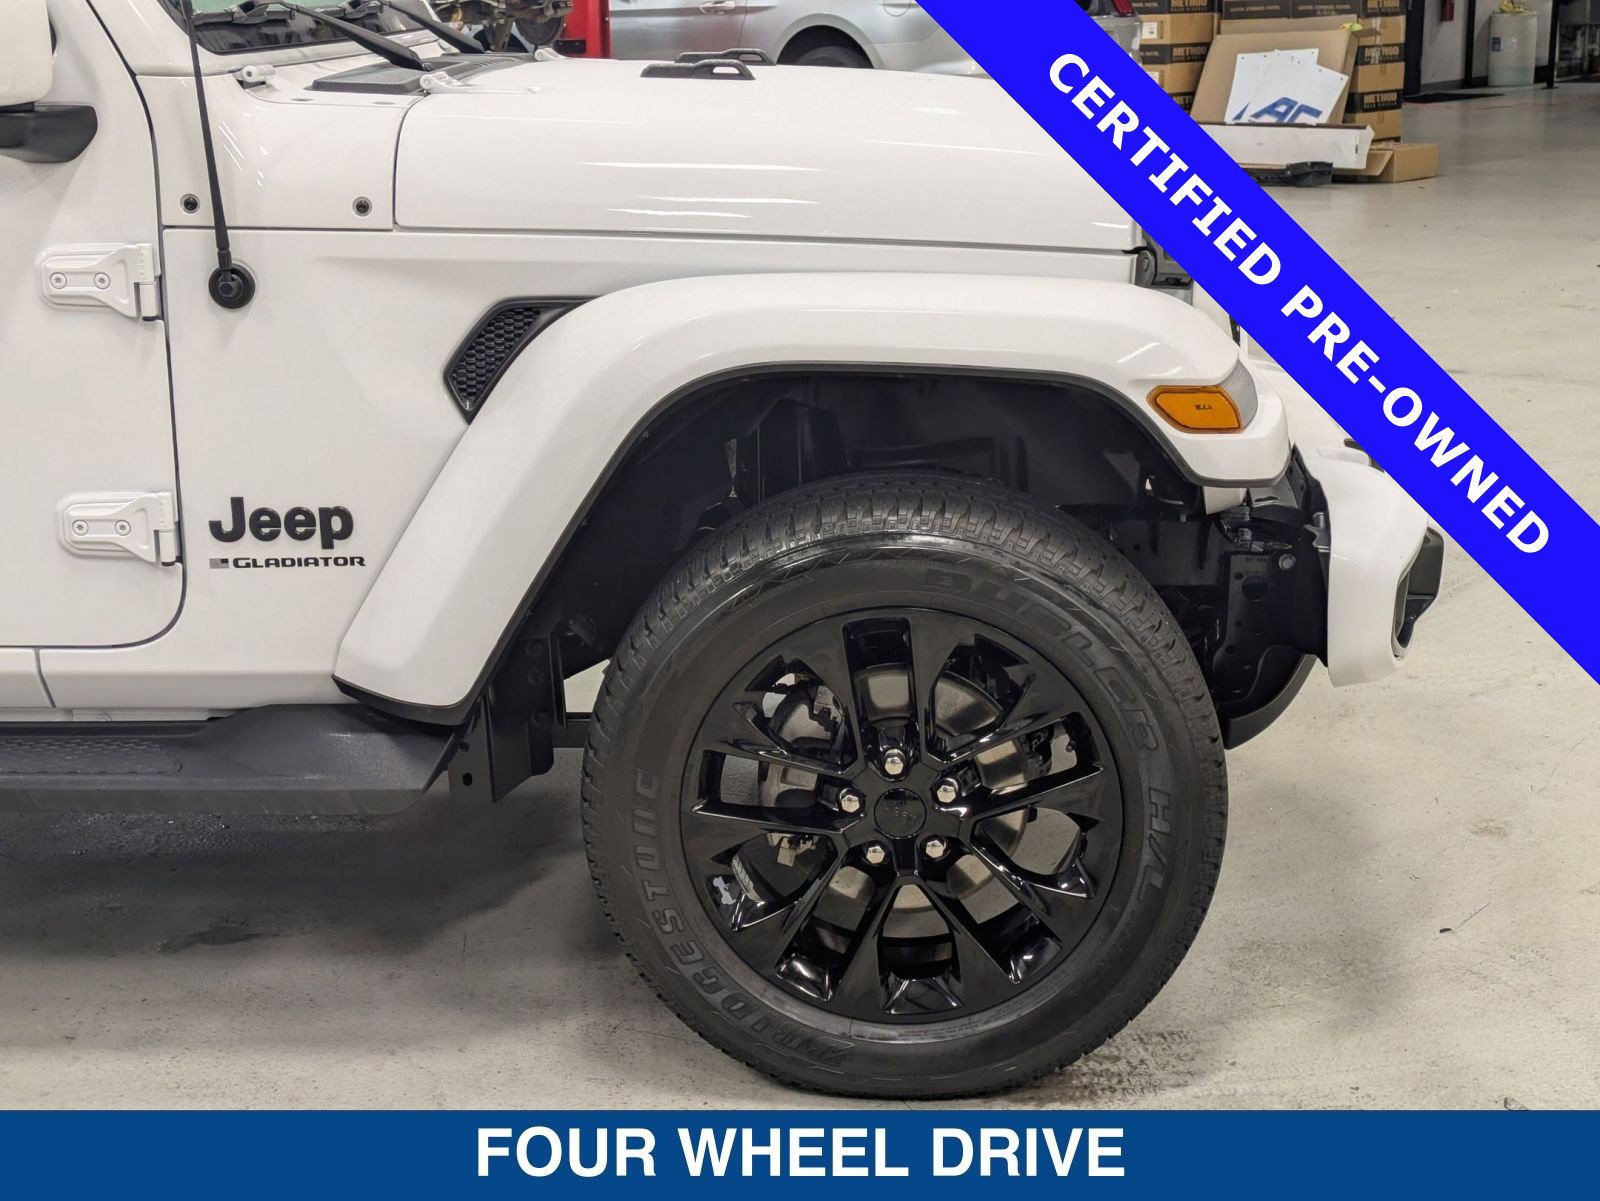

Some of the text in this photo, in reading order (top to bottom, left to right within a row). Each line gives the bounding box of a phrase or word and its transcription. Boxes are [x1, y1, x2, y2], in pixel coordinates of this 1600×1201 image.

[1363, 92, 1398, 104] METHOD
[208, 496, 354, 550] Jeep
[233, 556, 367, 569] GLADIATOR
[921, 566, 1159, 752] DUELER
[1137, 786, 1172, 901] H/L
[631, 769, 856, 1067] BRIDGESTONE
